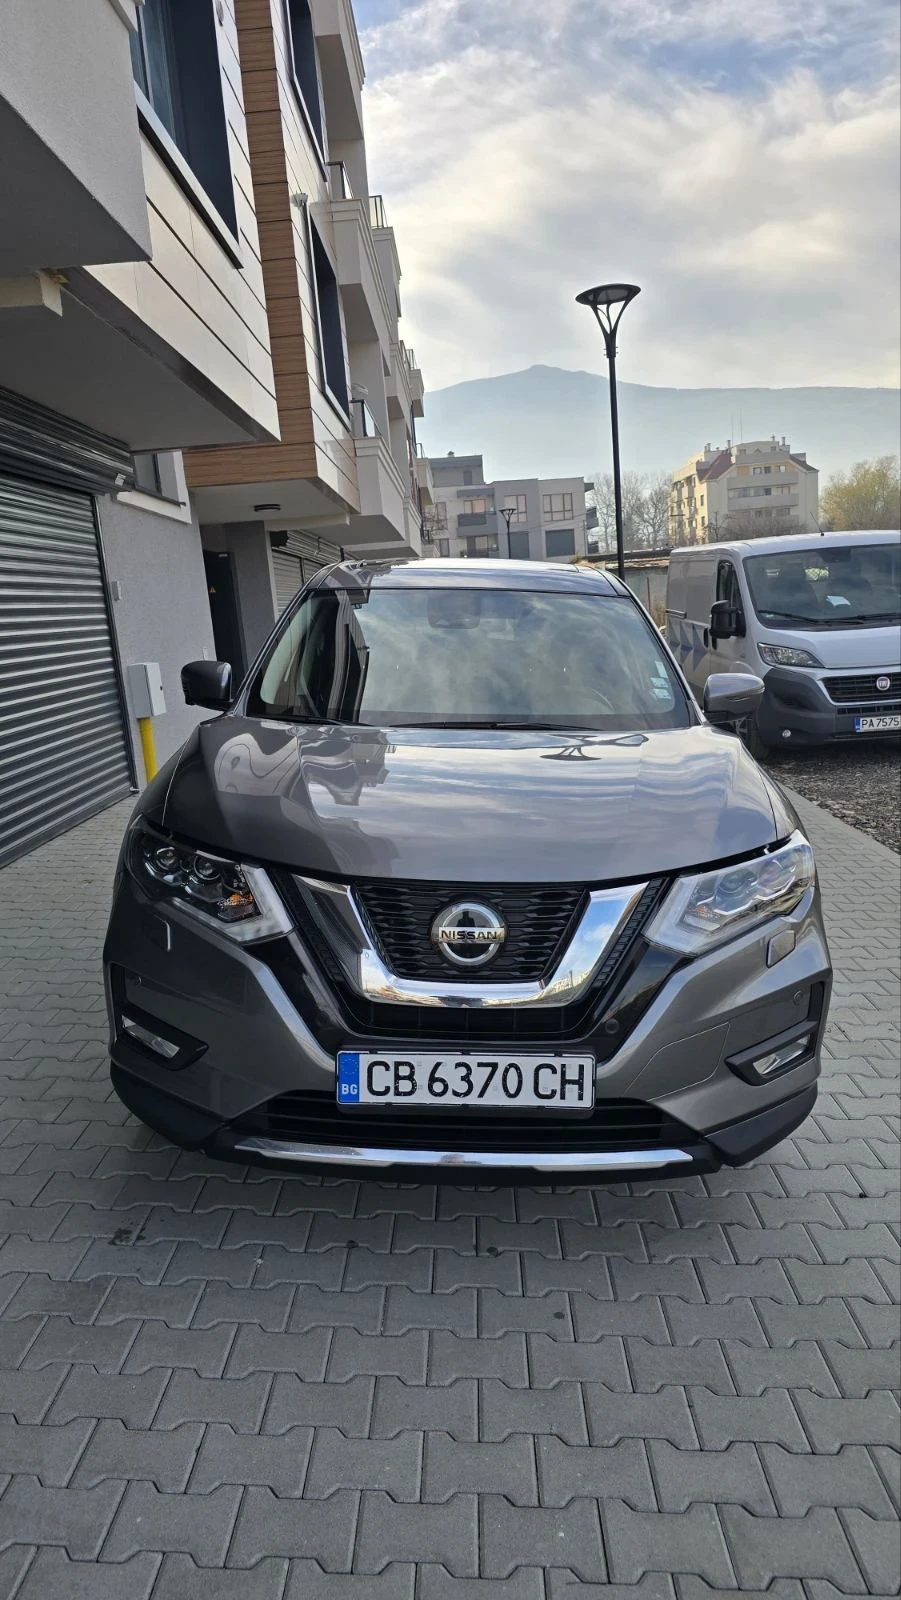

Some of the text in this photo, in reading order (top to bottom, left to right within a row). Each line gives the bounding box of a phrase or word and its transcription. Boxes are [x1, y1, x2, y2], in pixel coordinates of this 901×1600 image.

[862, 719, 875, 728] PA
[876, 717, 900, 727] 7575
[441, 930, 497, 940] NISSAN
[366, 1060, 584, 1101] CB 6370 CH
[341, 1083, 358, 1095] BG
